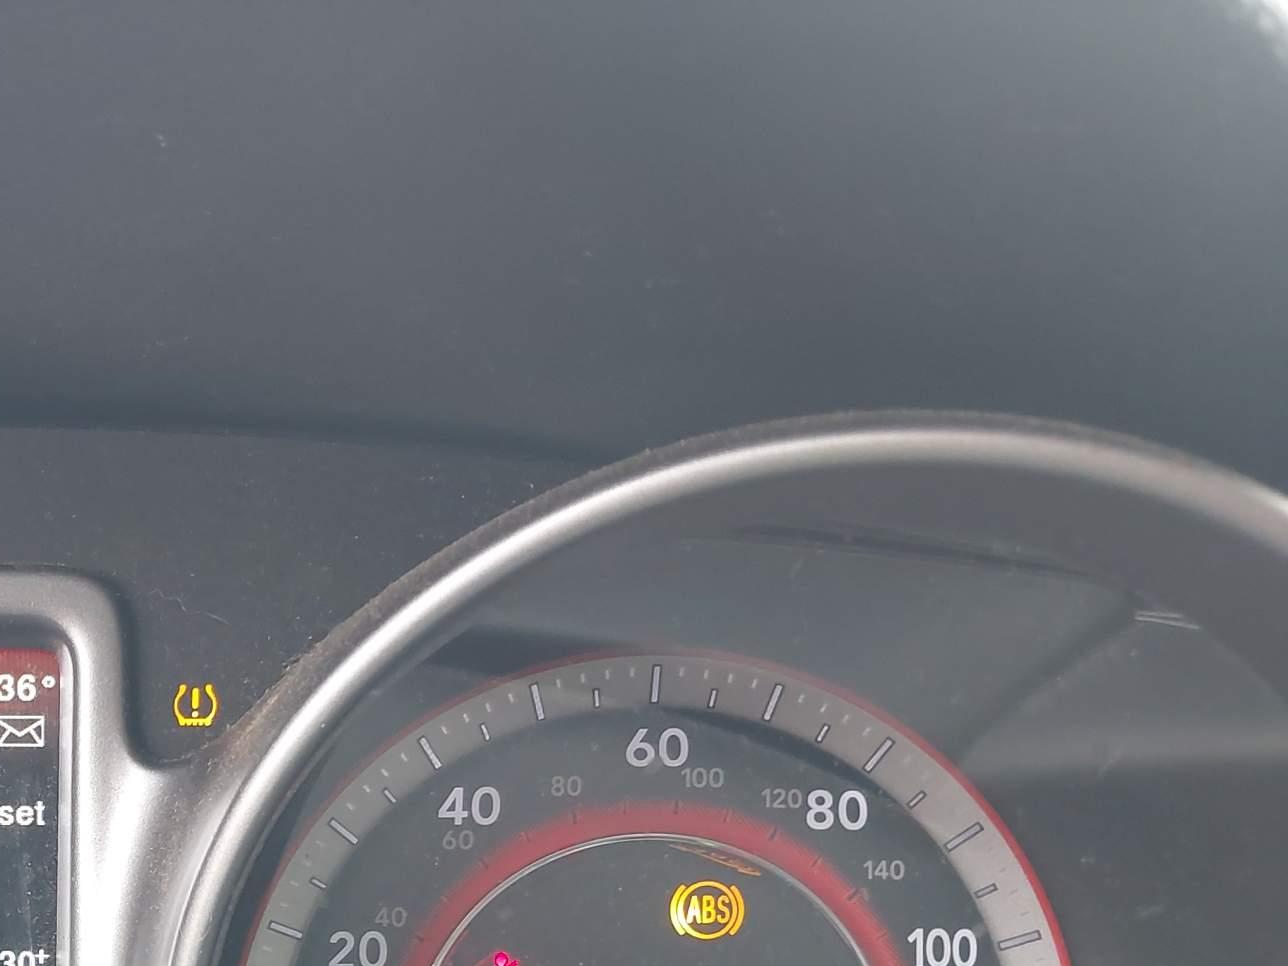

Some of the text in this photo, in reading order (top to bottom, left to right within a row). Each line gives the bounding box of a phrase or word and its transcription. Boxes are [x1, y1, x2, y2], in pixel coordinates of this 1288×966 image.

[626, 728, 689, 768] 60
[551, 776, 582, 796] 80
[681, 768, 724, 788] 100
[438, 787, 500, 825] 40
[761, 789, 802, 809] 120
[806, 790, 868, 830] 80
[442, 831, 473, 850] 60
[864, 860, 905, 880] 140
[375, 907, 406, 927] 40
[687, 895, 730, 924] ABS
